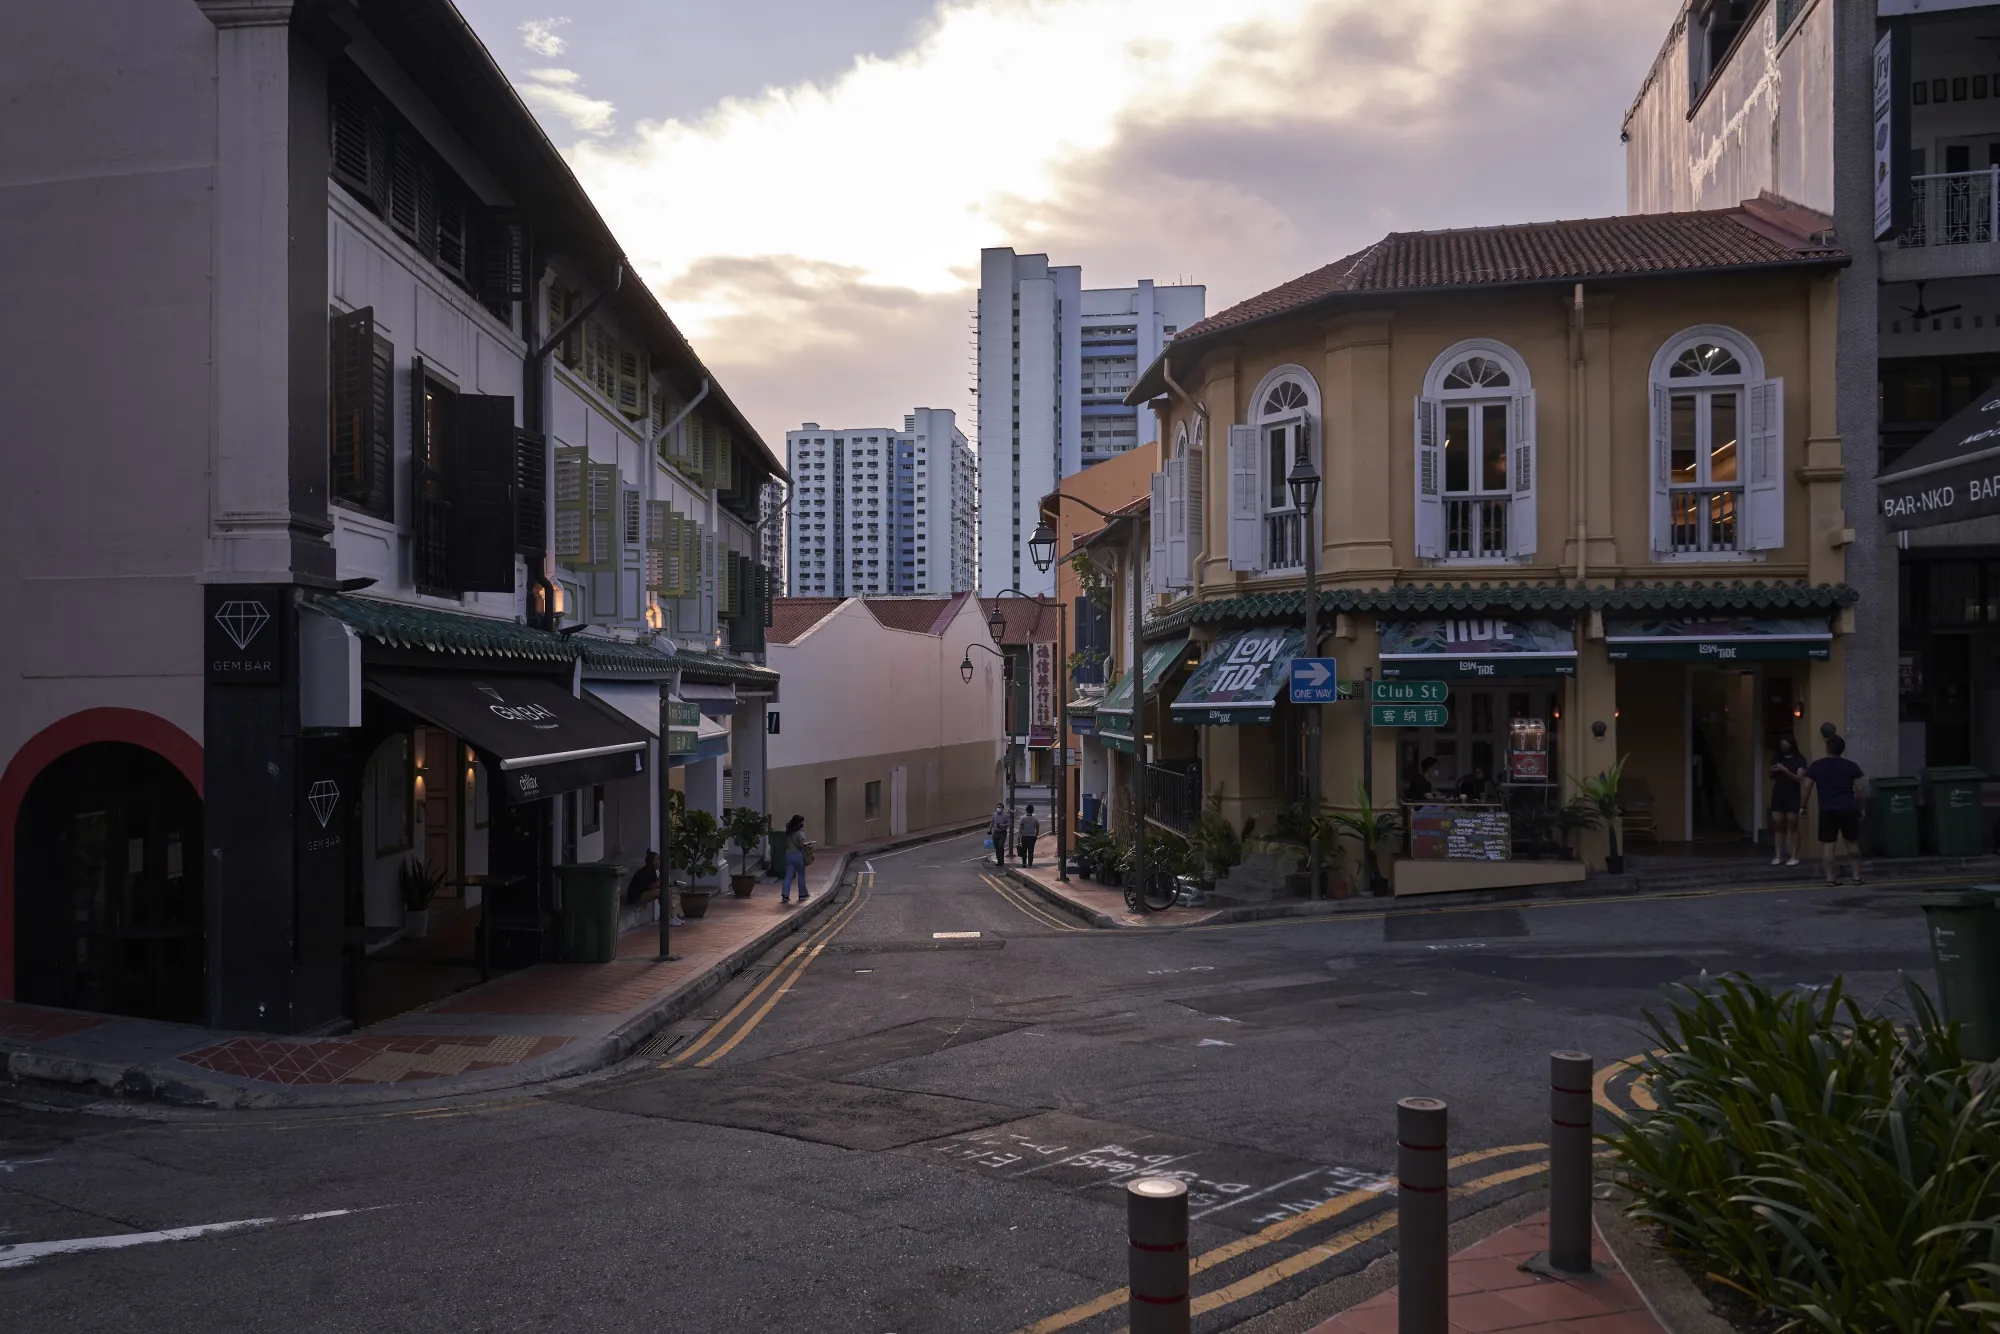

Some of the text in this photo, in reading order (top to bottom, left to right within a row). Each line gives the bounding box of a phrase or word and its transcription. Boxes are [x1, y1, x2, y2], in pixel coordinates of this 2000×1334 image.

[1718, 647, 1736, 659] TIDE
[213, 660, 272, 671] GEM BAR
[1476, 664, 1495, 676] TIDE
[1211, 663, 1271, 693] TIDE
[1294, 688, 1332, 699] ONE WAY
[1377, 684, 1438, 698] Club St
[1382, 709, 1438, 723] 客纳街
[308, 835, 341, 852] GEM BAR
